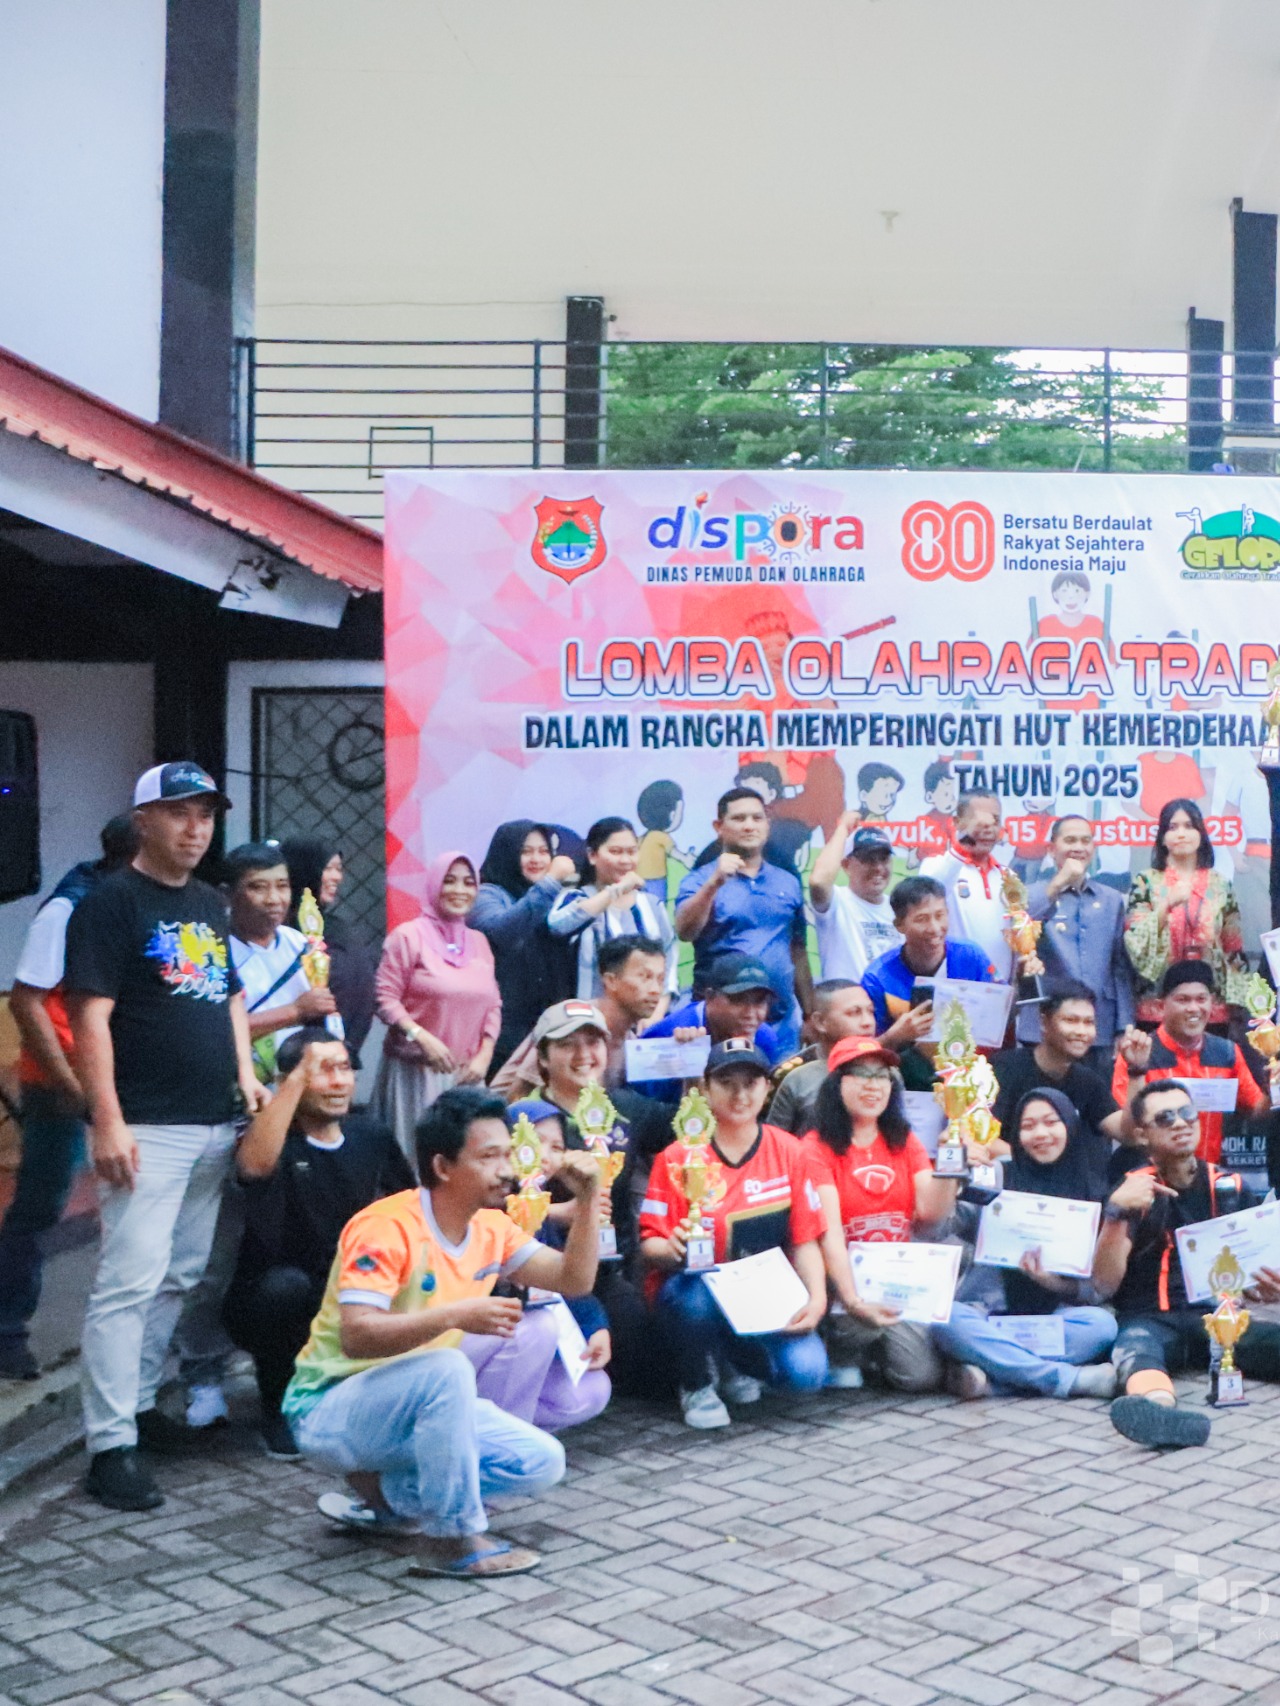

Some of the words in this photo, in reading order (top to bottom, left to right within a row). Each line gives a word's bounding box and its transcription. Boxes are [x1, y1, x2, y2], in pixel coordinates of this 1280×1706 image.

[647, 502, 864, 561] dispora
[1003, 514, 1067, 530] Bersatu
[1073, 515, 1153, 531] Berdaulat
[901, 500, 995, 582] 80
[1003, 534, 1060, 554] Rakyat
[1065, 535, 1145, 554] Sejahtera
[647, 566, 688, 582] DINAS
[695, 566, 753, 582] PEMUDA
[759, 566, 786, 582] DAN
[793, 566, 866, 582] OLAHRAGA
[1003, 556, 1083, 571] Indonesia
[1089, 556, 1127, 575] Maju
[566, 641, 772, 697] LOMBA
[789, 641, 1114, 696] OLAHRAGA
[525, 713, 629, 749] DALAM
[641, 712, 765, 749] RANGKA
[777, 712, 1002, 747] MEMPERINGATI
[1014, 712, 1071, 747] HUT
[954, 764, 1050, 798] TAHUN
[1064, 764, 1138, 798] 2025
